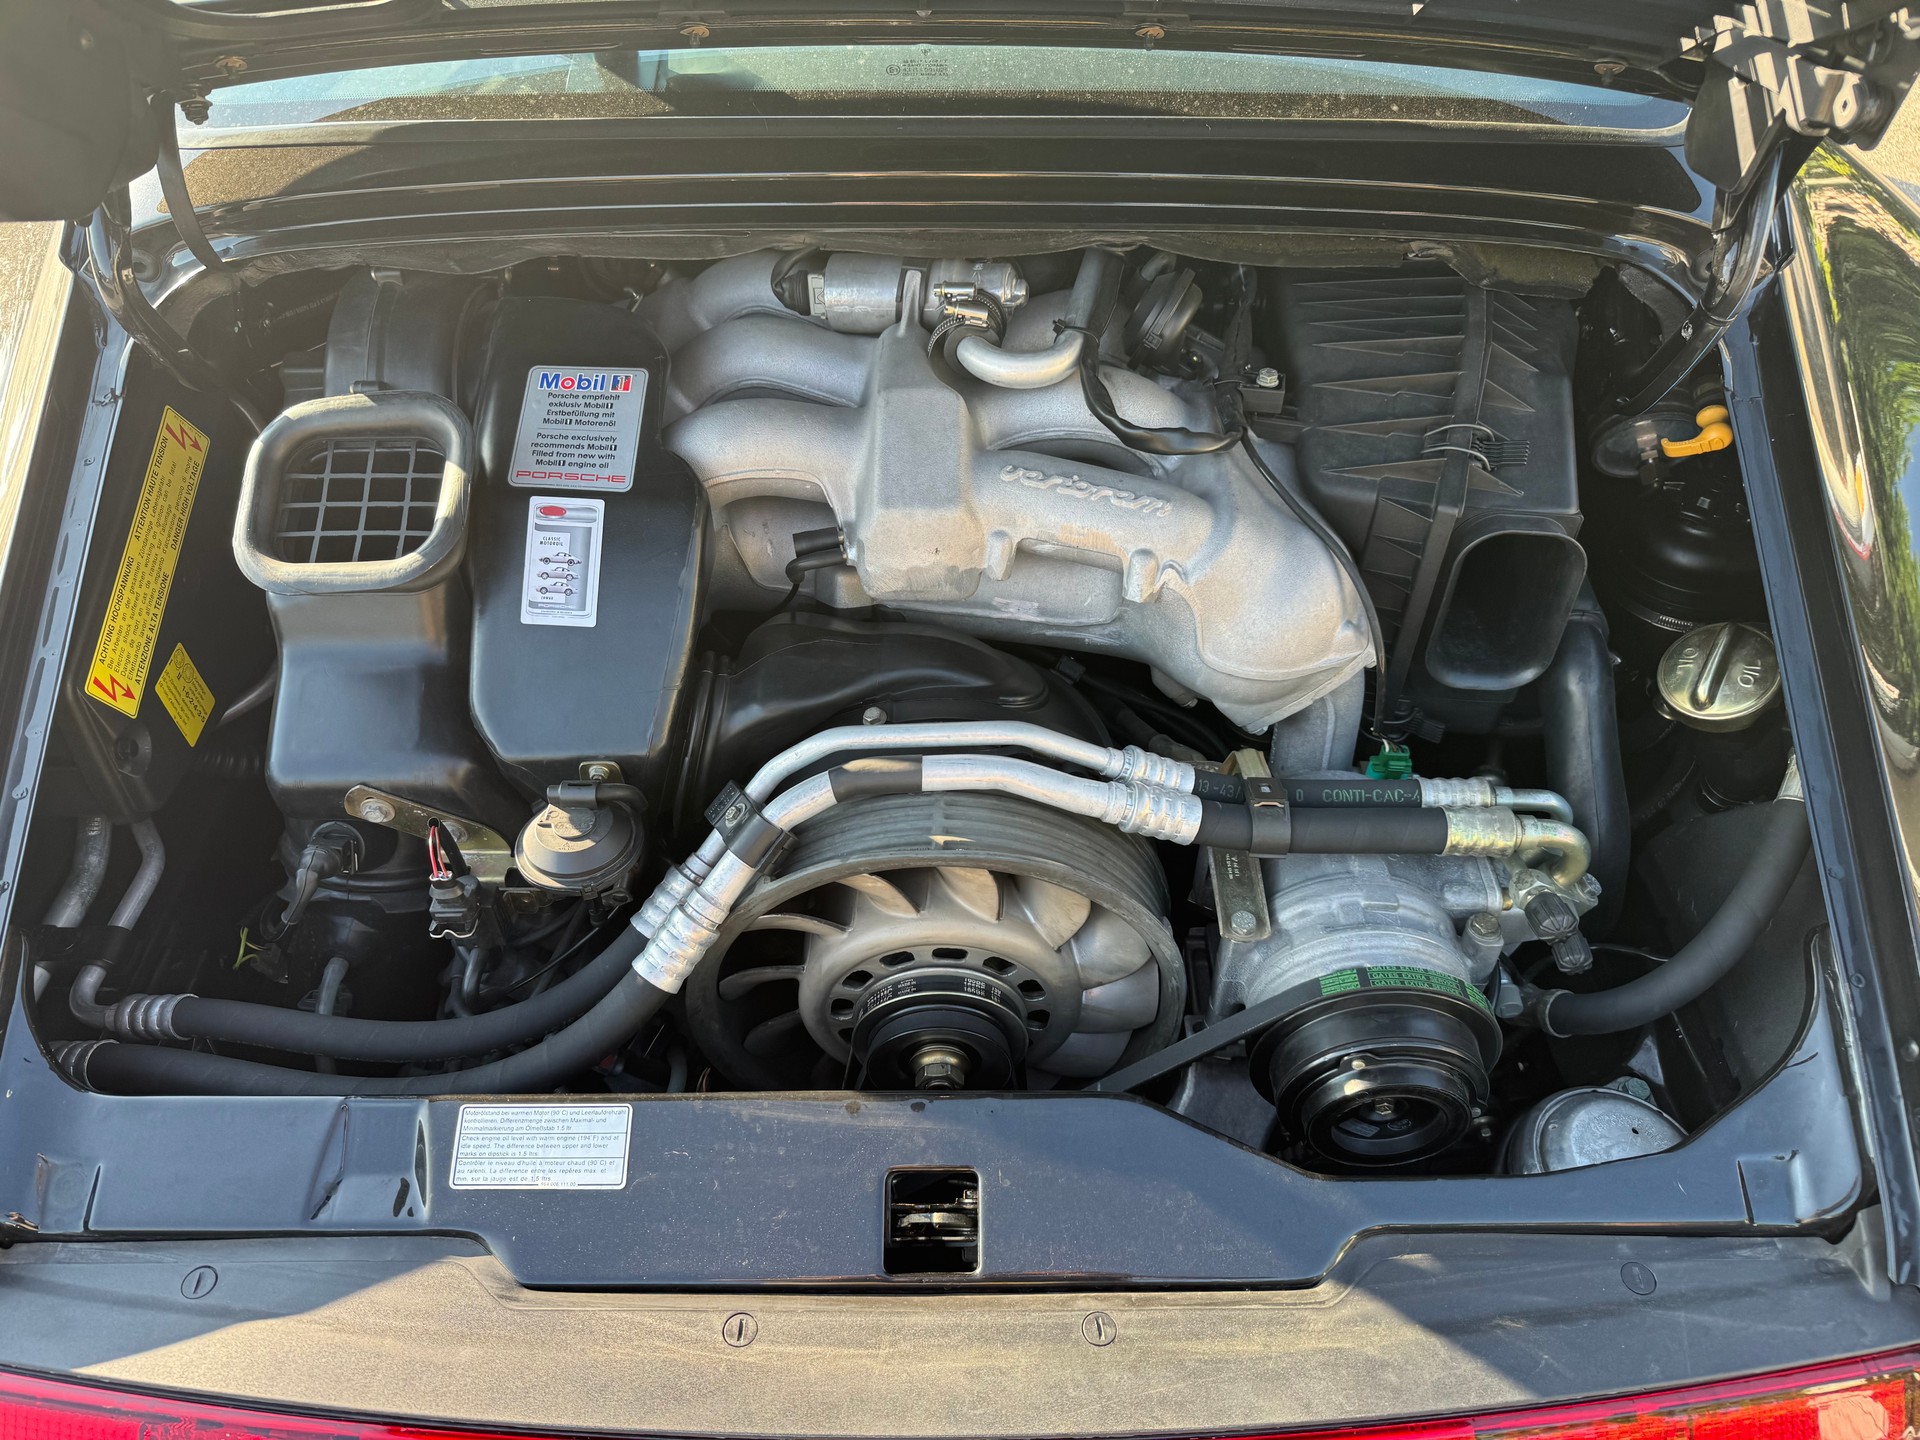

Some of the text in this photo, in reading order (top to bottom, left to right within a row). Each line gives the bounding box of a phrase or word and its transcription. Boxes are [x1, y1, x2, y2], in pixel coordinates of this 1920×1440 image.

[539, 372, 606, 391] Mobil
[547, 409, 599, 418] Erstbefüllung
[168, 460, 176, 476] fatal
[516, 471, 626, 483] PORSCHE
[134, 435, 168, 541] ATTENTION HAUTE TENSION
[165, 477, 171, 487] be
[154, 503, 165, 528] ignition
[170, 460, 199, 551] DANGER HIGH VOLTAGE
[152, 530, 157, 539] on
[111, 624, 123, 654] Arbeiten
[121, 612, 127, 621] an
[129, 561, 142, 594] gesamten
[138, 519, 153, 559] Zündanlage
[150, 474, 166, 518] Lebensgefahr
[127, 640, 141, 680] Effettuando
[138, 618, 147, 638] lavori
[153, 556, 165, 585] impianto
[174, 484, 185, 511] pericolo
[181, 475, 186, 483] di
[184, 455, 192, 473] morte
[143, 541, 155, 568] working
[137, 570, 146, 589] when
[98, 555, 134, 664] ACHTUNG HOCHSPANNUNG
[120, 650, 132, 677] Danger
[128, 638, 134, 648] de
[132, 619, 140, 635] mort
[138, 607, 143, 616] en
[145, 579, 151, 589] de
[148, 552, 158, 577] travaux
[128, 591, 140, 620] suffered
[122, 622, 131, 643] shock
[134, 571, 169, 685] ATTENZIONE ALTA TENSIONE
[113, 646, 125, 673] Electric
[1678, 648, 1698, 673] OIL
[1737, 660, 1762, 688] OIL
